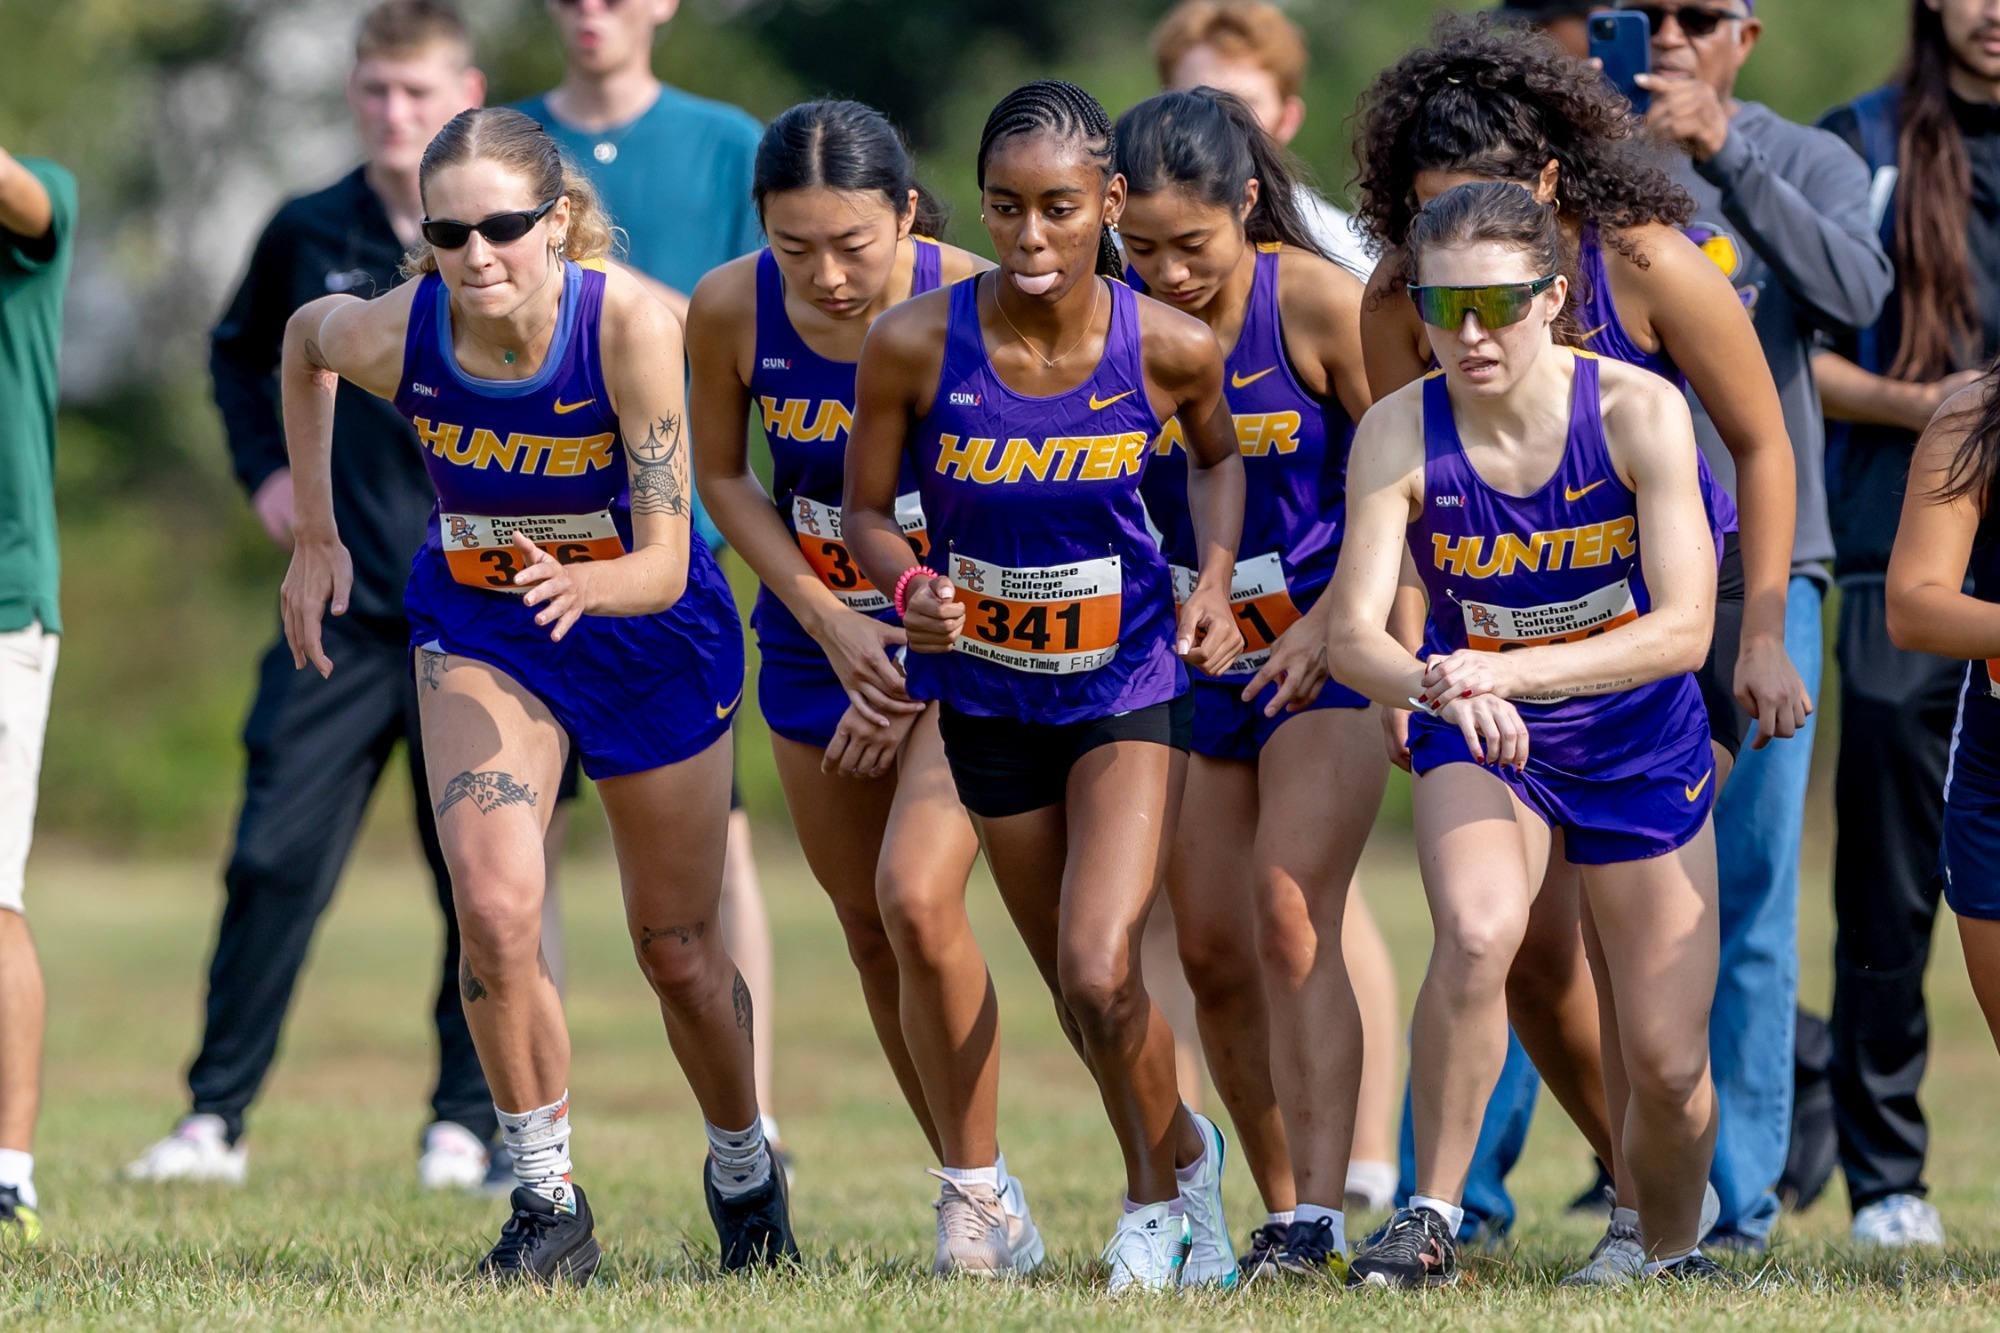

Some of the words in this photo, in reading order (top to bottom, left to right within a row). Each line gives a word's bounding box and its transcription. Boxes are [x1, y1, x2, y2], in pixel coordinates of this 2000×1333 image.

[413, 416, 615, 476] HUNTER
[935, 431, 1148, 484] HUNTER
[491, 517, 567, 528] Purchase
[1432, 515, 1636, 579] HUNTER
[1001, 567, 1079, 580] Purchase
[1001, 579, 1063, 591] College
[1001, 585, 1098, 600] Invitational
[1511, 601, 1588, 619] Purchase
[1513, 613, 1575, 628] College
[976, 599, 1081, 650] 341
[1516, 609, 1613, 637] Invitational
[962, 641, 989, 658] Fulton
[989, 649, 1028, 668] Accurate
[1029, 657, 1060, 672] Timing
